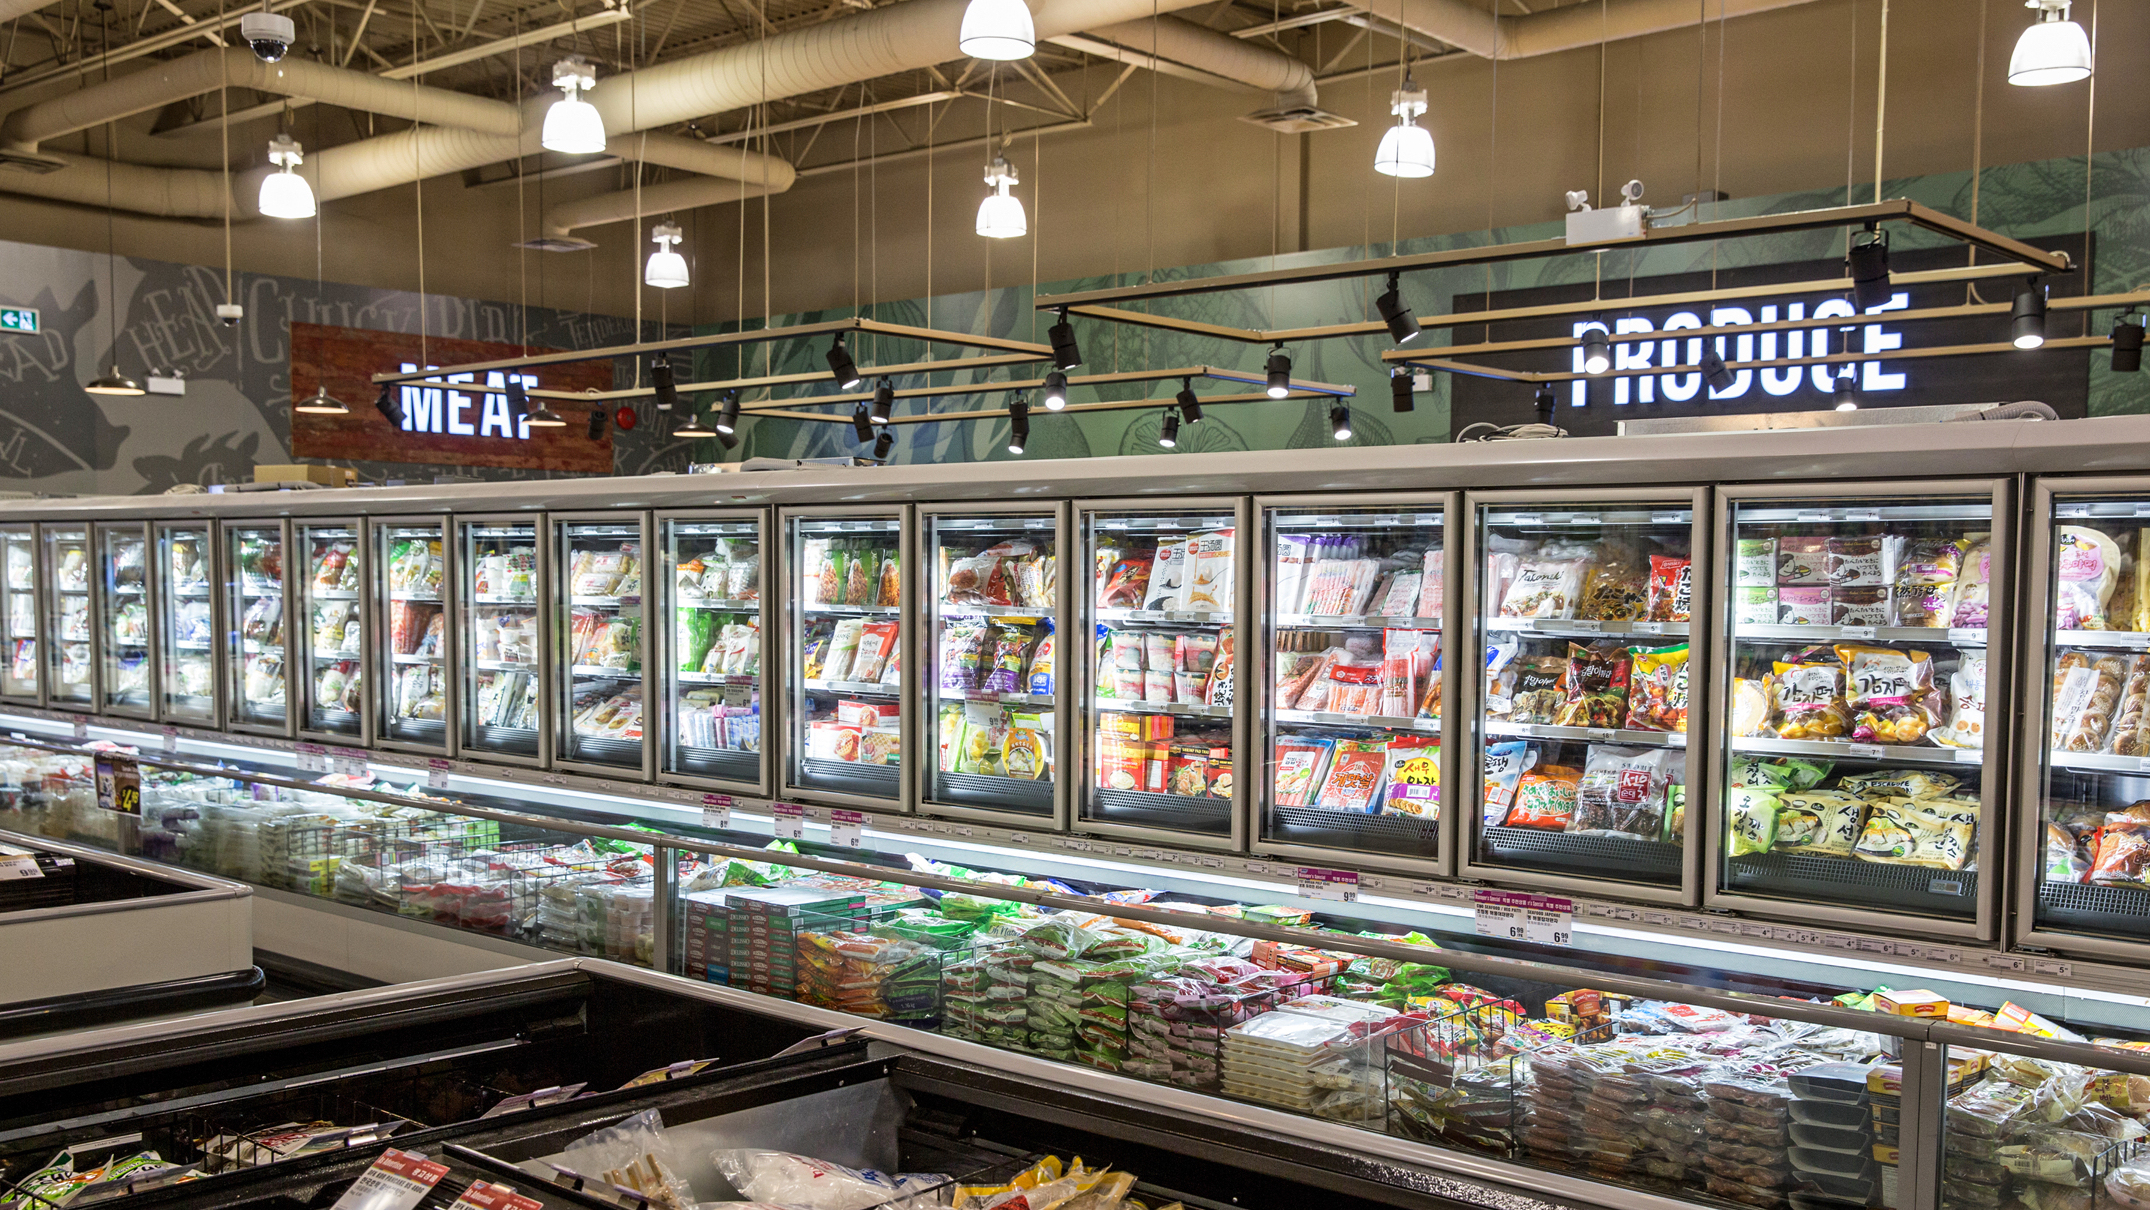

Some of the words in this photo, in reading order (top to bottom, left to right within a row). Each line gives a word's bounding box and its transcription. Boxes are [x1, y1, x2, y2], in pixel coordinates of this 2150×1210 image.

[1571, 292, 1909, 407] PRODUCE
[400, 362, 538, 440] MEAT
[1782, 682, 1834, 703] 감자떡
[1404, 762, 1430, 776] 새우
[1332, 772, 1374, 790] 게맛살
[412, 1168, 439, 1183] 광고상품
